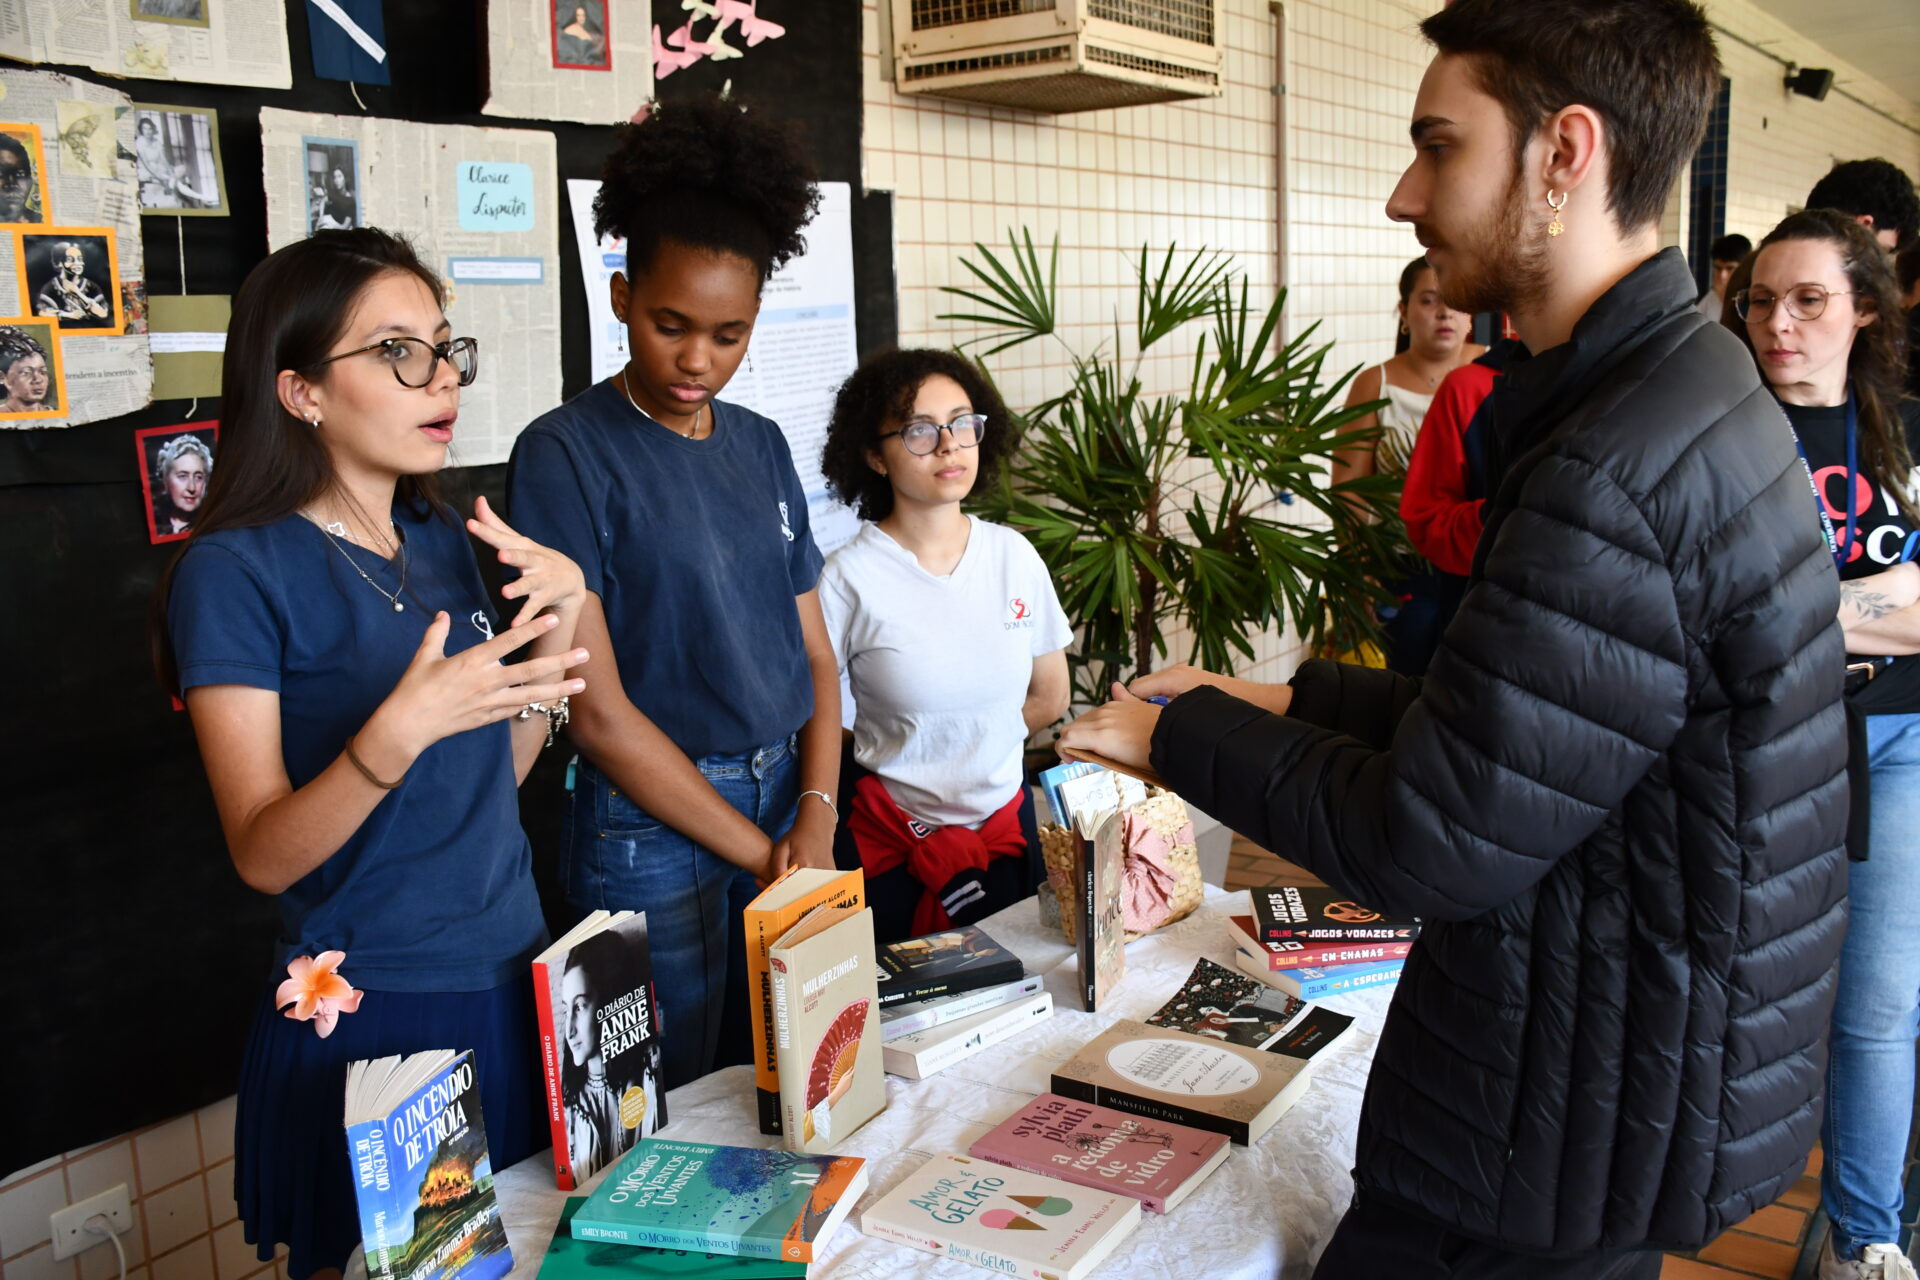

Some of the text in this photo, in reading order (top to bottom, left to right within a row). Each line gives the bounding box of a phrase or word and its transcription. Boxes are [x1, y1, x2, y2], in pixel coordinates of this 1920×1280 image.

[828, 890, 846, 904] ALCOTT
[1267, 893, 1291, 924] JOGOS
[1283, 887, 1309, 923] VORAZES
[1269, 929, 1395, 938] COLLINS JOGOS VORAZES
[1276, 948, 1384, 965] COLLINS EM CHAMAS
[802, 955, 858, 997] MULHERZINHAS
[1308, 984, 1328, 994] COLLINS
[1343, 979, 1350, 988] A
[596, 985, 646, 1021] O DIÁRIO DE
[600, 998, 649, 1044] ANNE
[761, 971, 777, 1072] MULHERZINHAS
[775, 977, 790, 1049] MULHERZINHAS
[600, 1021, 651, 1064] FRANK
[394, 1063, 473, 1146] O INCÊNDIO
[551, 1098, 560, 1122] FRANK
[1012, 1101, 1068, 1138] sylvia
[1110, 1097, 1184, 1121] MANSFIELD PARK
[405, 1101, 468, 1171] DE TRÓIA
[1042, 1107, 1093, 1144] plath
[356, 1139, 374, 1188] DE TRÓIA
[370, 1129, 391, 1191] O INCÊNDIO
[1052, 1152, 1073, 1165] a
[1072, 1120, 1140, 1172] redoma
[616, 1154, 661, 1192] MORRO
[635, 1155, 686, 1208] DOS VENTOS
[652, 1160, 704, 1206] UIVANTES
[1099, 1160, 1129, 1179] de
[1124, 1149, 1176, 1186] vidro
[609, 1191, 630, 1203] O
[909, 1177, 966, 1212] AMOR
[931, 1176, 1005, 1225] GELATO
[412, 1254, 437, 1280] Marion
[435, 1229, 465, 1265] Zimmer
[462, 1208, 491, 1238] Bradley
[581, 1228, 600, 1237] EMILY
[638, 1232, 647, 1240] O
[649, 1233, 680, 1244] MORRO
[696, 1237, 729, 1248] VENTOS
[731, 1241, 772, 1252] UIVANTES
[948, 1243, 971, 1259] AMOR
[980, 1251, 1017, 1274] GELATO
